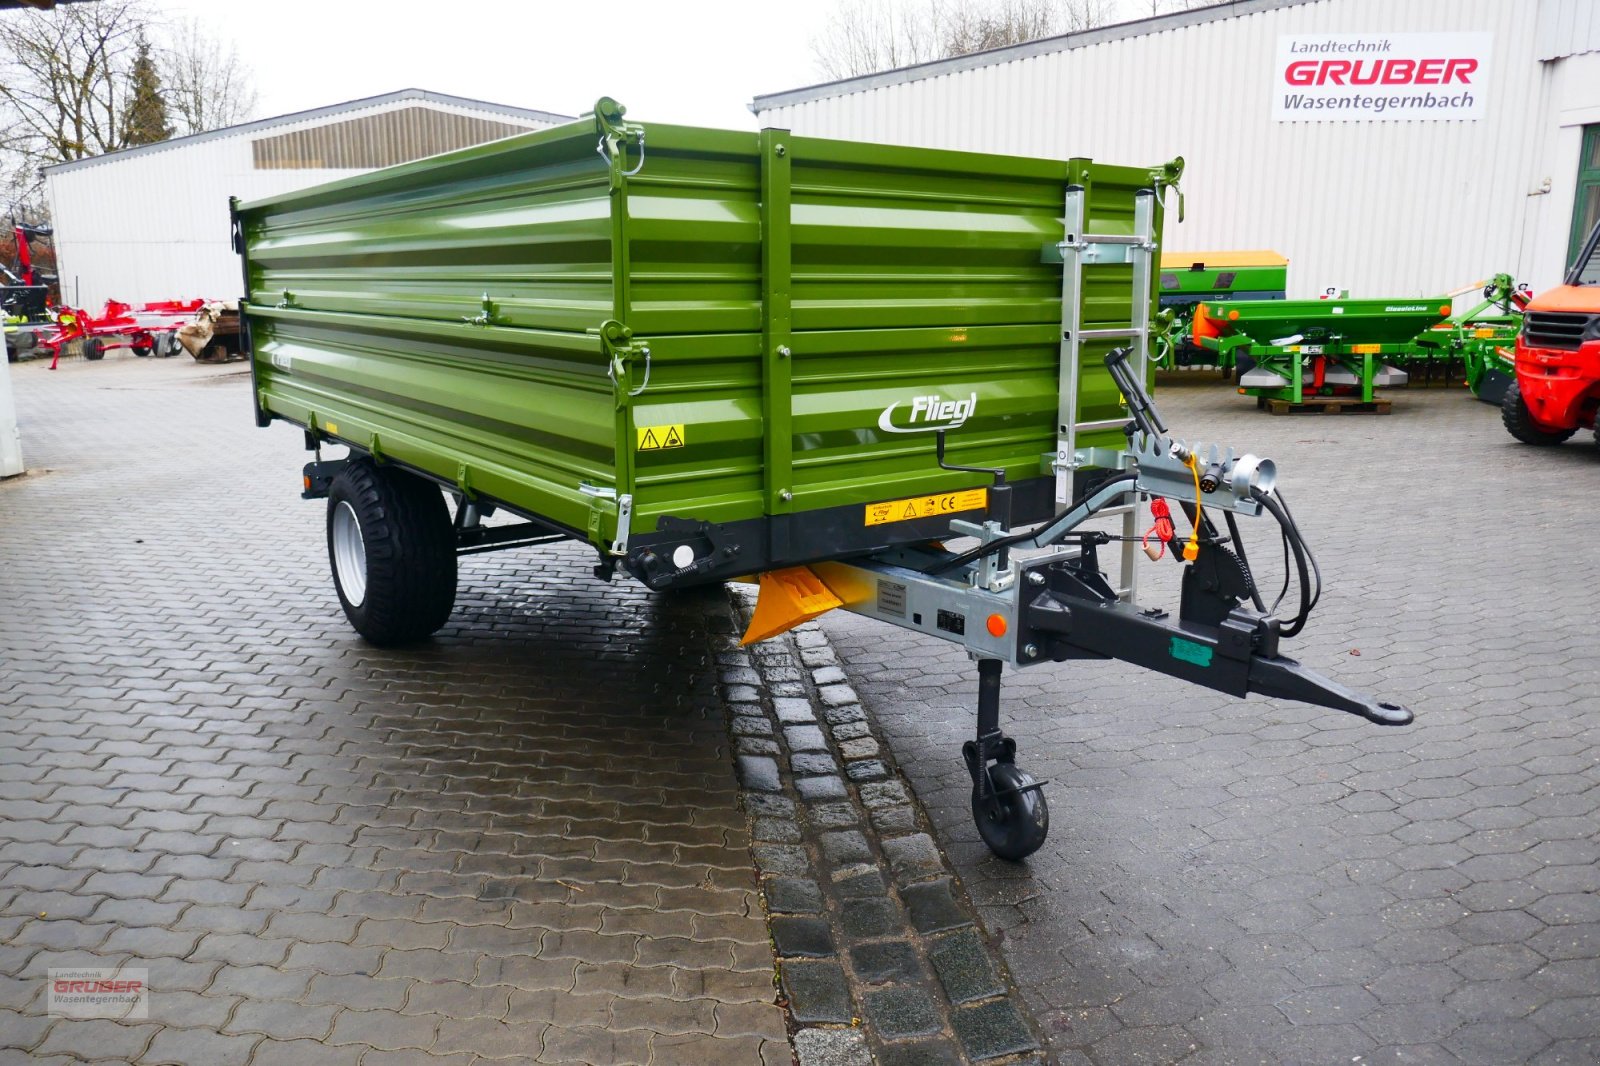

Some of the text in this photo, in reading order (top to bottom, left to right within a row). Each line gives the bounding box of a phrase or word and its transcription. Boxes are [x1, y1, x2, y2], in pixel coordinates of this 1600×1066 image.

[1290, 39, 1392, 54] Landtechnik
[1284, 58, 1479, 86] GRUBER
[1283, 91, 1474, 113] Wasentegernbach
[909, 391, 977, 425] Fliegl
